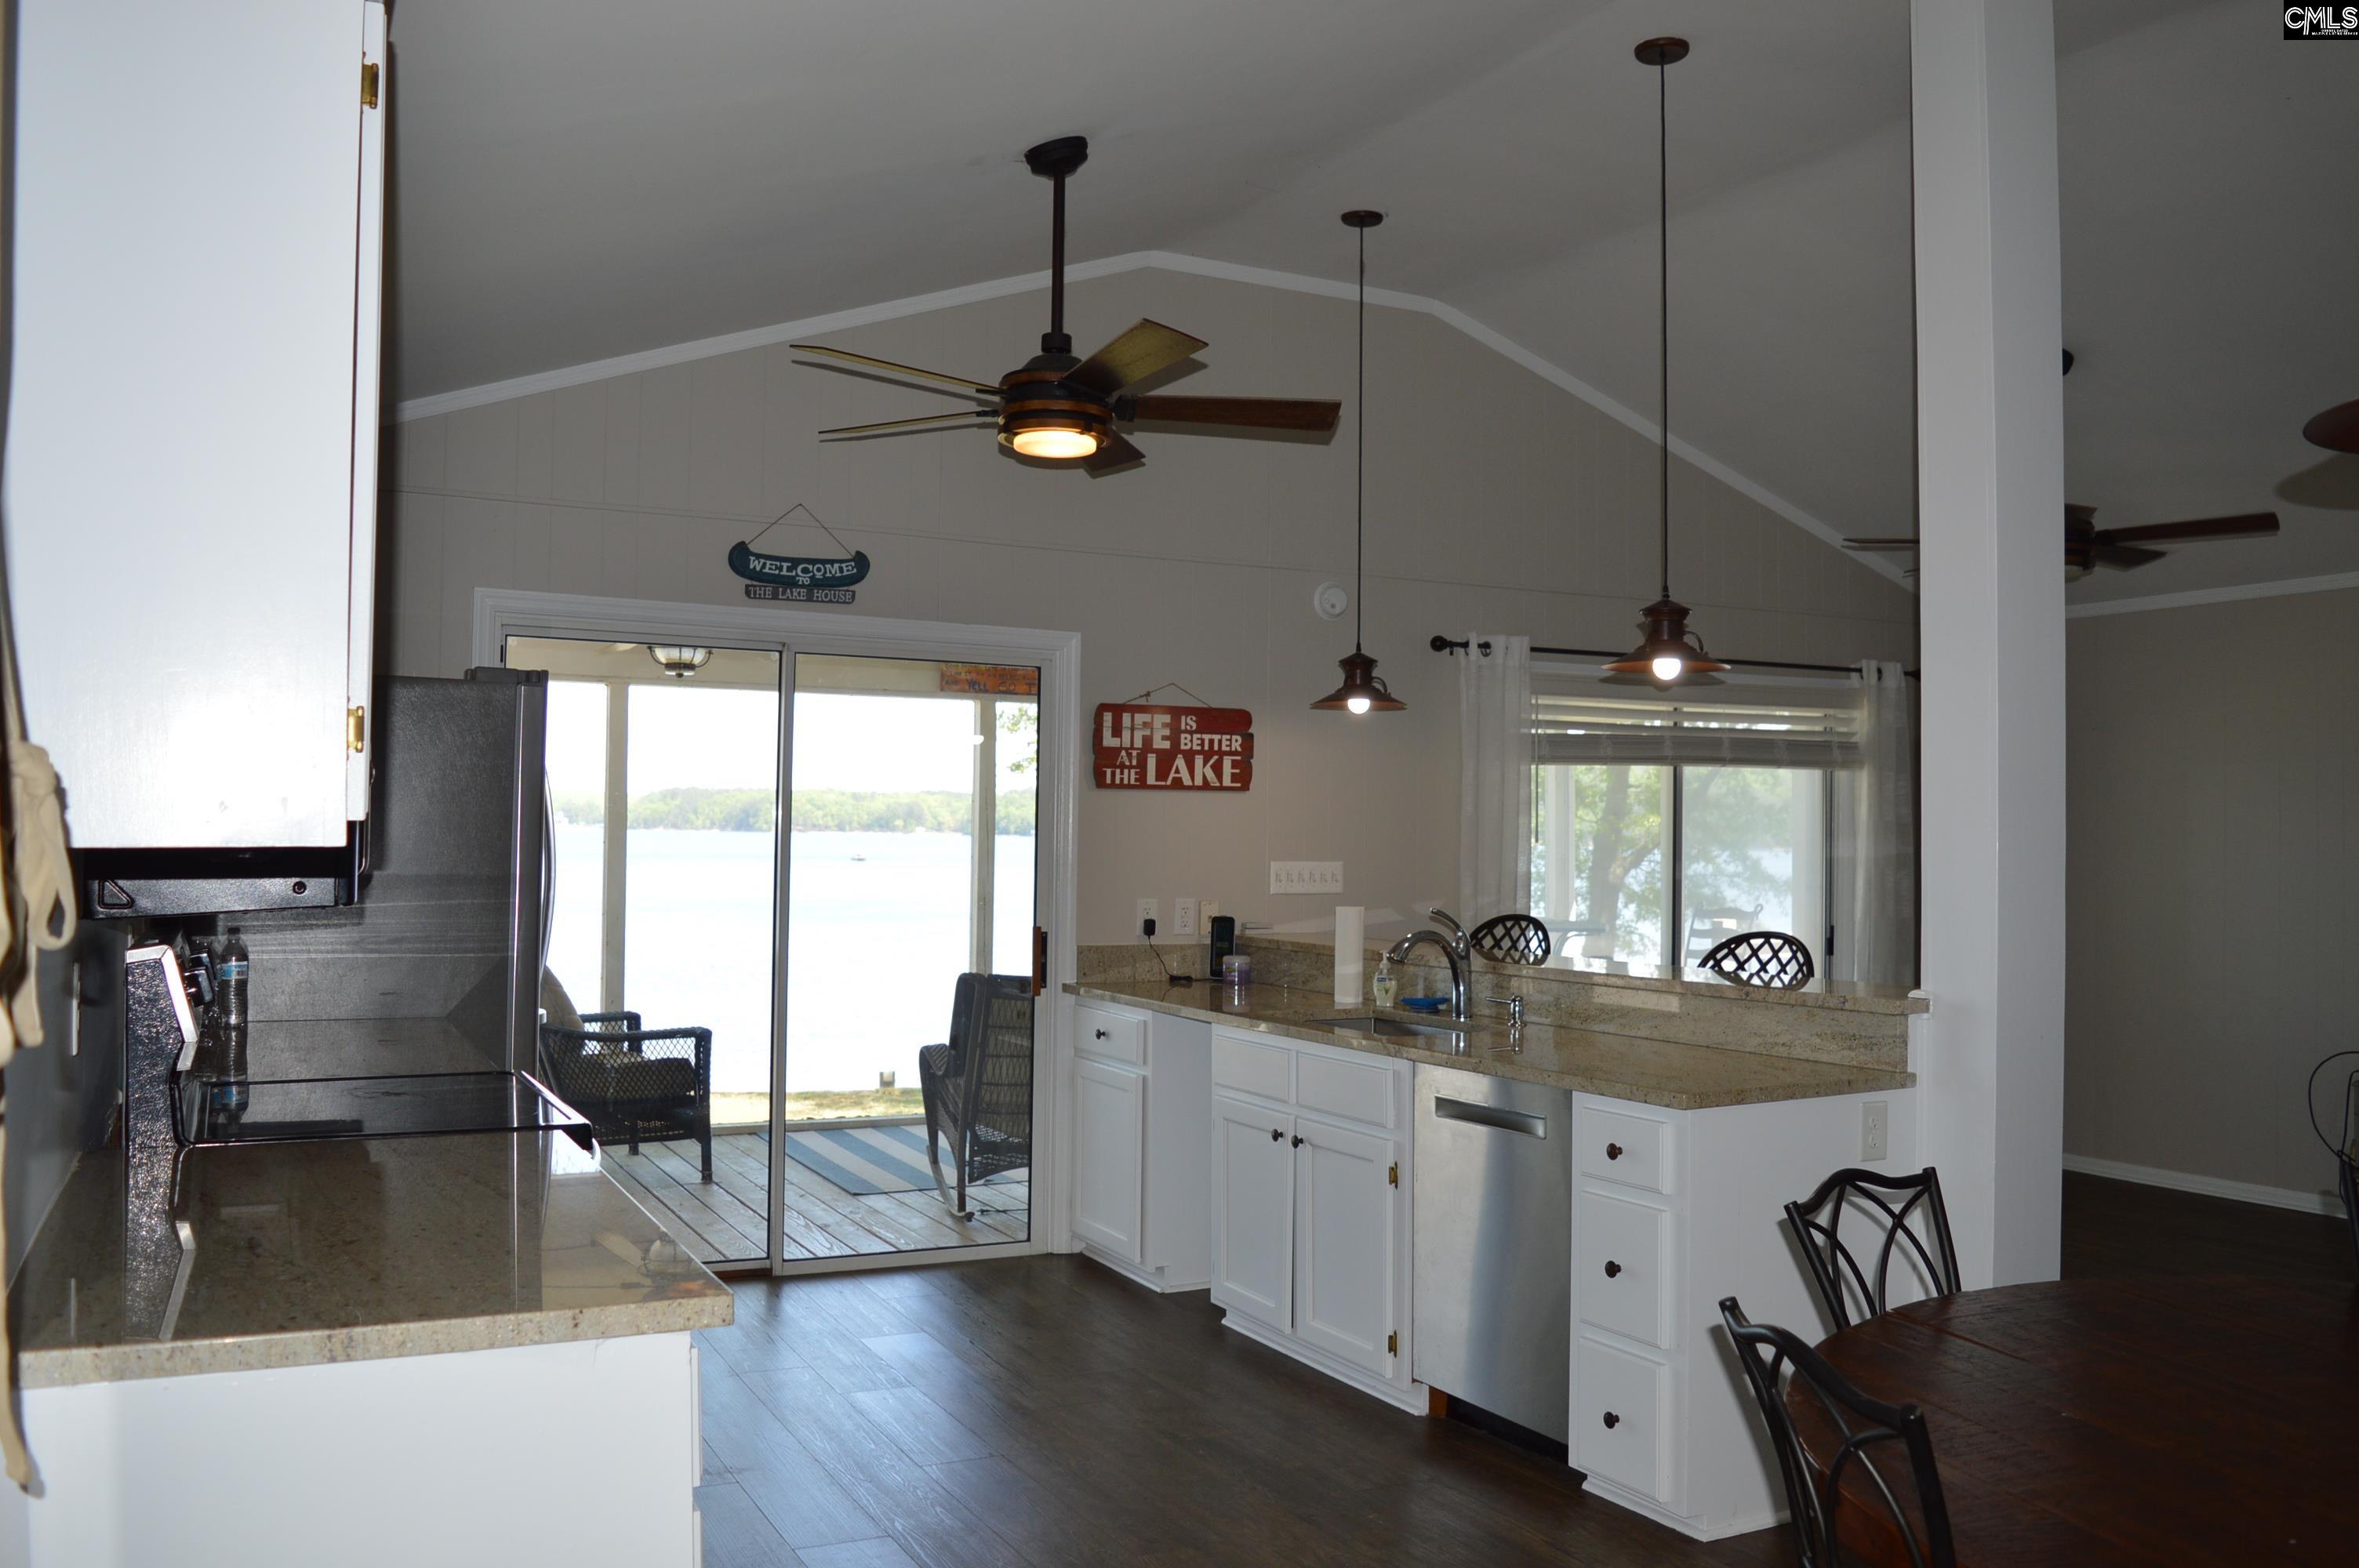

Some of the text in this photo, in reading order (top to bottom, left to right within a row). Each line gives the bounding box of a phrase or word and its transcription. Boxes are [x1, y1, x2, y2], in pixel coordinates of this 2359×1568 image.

[748, 556, 857, 579] WELCOME
[748, 587, 853, 602] THE LAKE HOUSE
[1103, 712, 1197, 749] LIFE IS
[1180, 733, 1242, 751] BETTER
[1116, 750, 1141, 766] AT
[1102, 753, 1241, 787] THE LAKE
